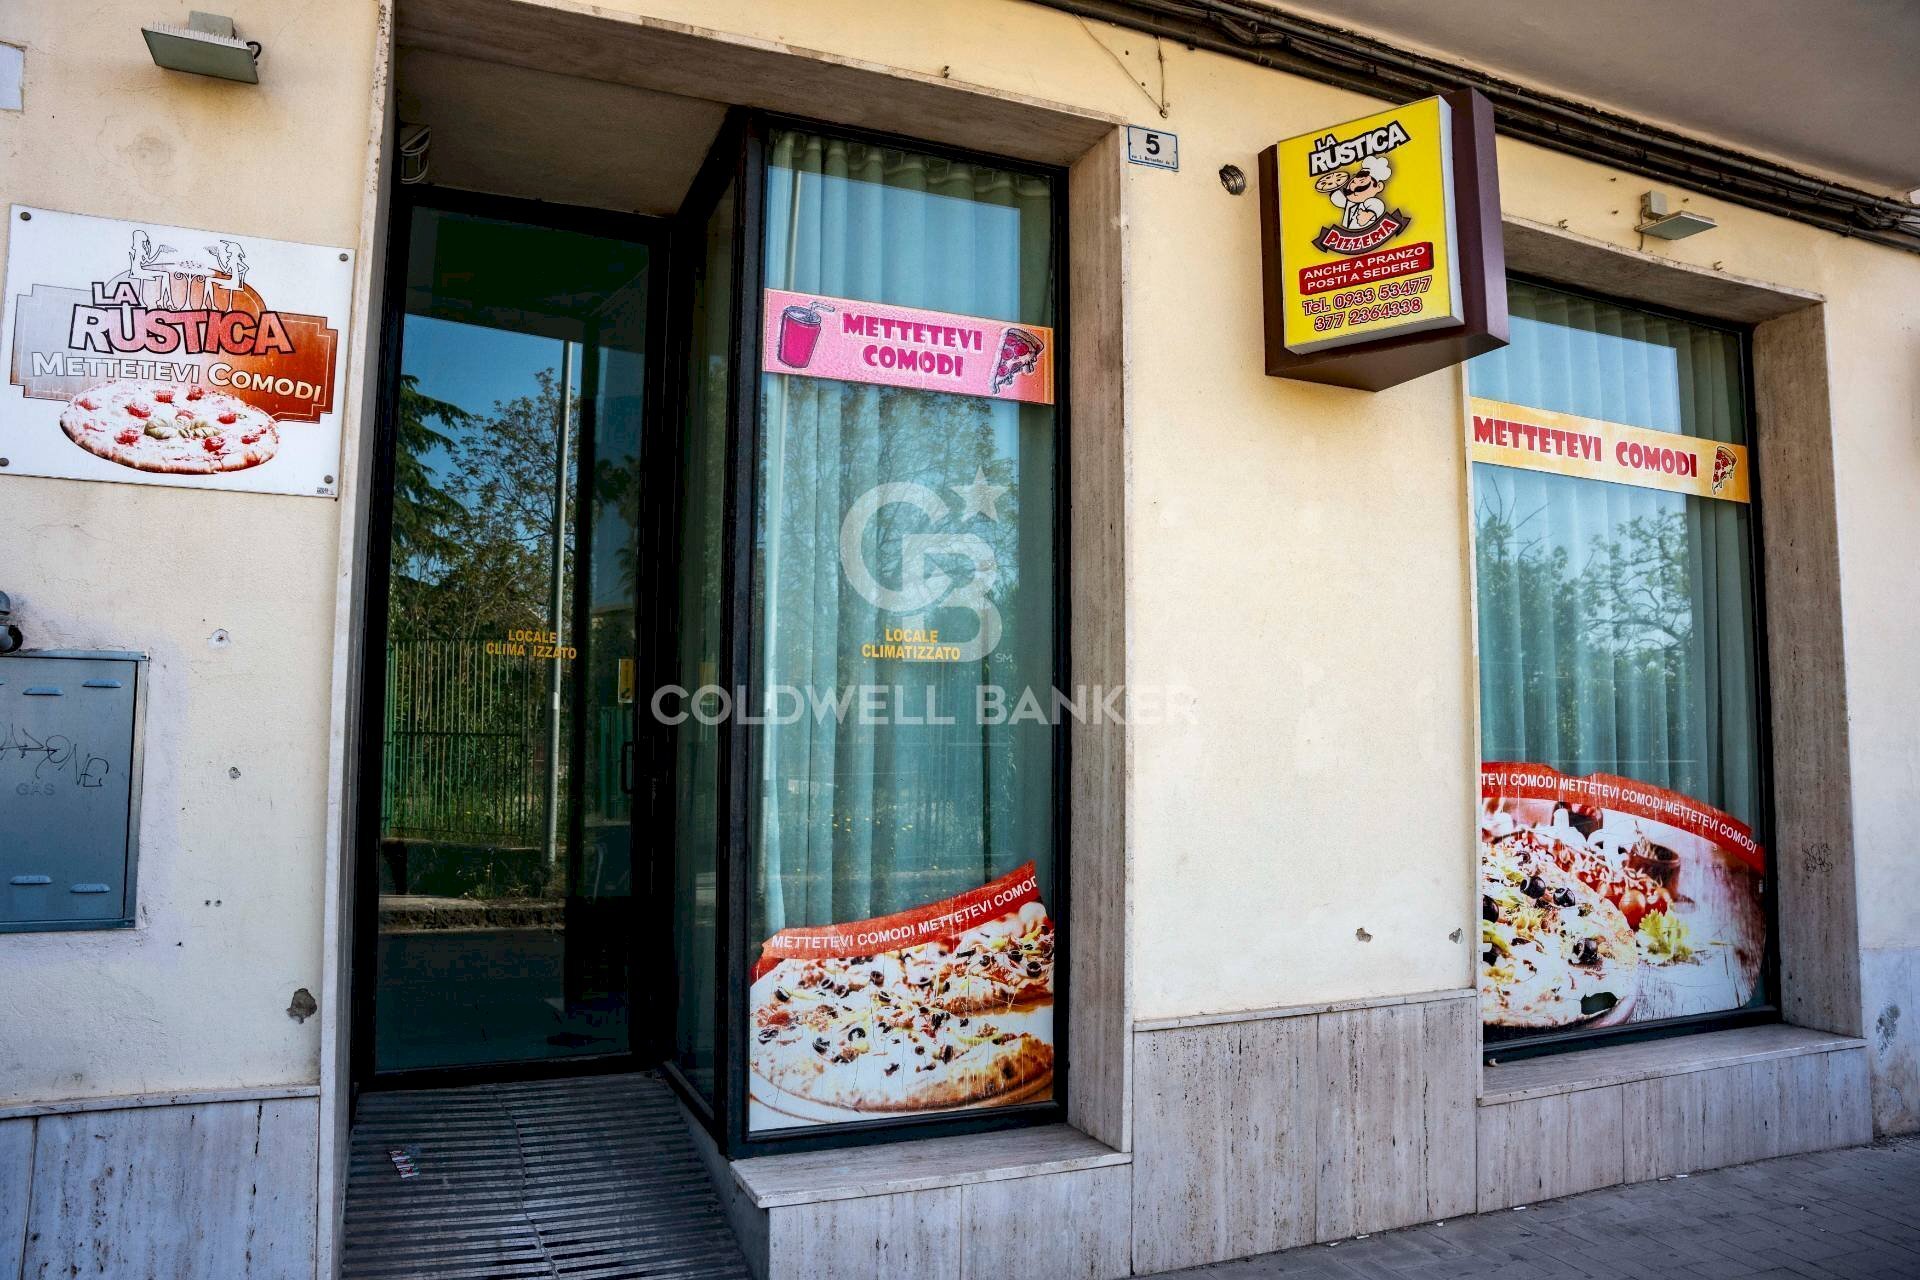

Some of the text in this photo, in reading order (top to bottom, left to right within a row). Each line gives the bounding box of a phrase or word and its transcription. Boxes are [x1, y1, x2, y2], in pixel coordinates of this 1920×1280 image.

[1146, 133, 1160, 155] 5
[1309, 121, 1410, 176] RUSTICA
[1315, 134, 1338, 151] LA
[1323, 218, 1400, 251] PIZZERIA
[1304, 246, 1425, 280] ANCHE A PRANZO
[1307, 260, 1419, 290] POSTI A SEDERE
[92, 282, 140, 306] LA
[1302, 275, 1432, 316] Tel. 0933 53477
[69, 303, 296, 355] RUSTICA
[1314, 297, 1422, 331] 377 2364338
[842, 312, 983, 351] METTETEVI
[32, 351, 321, 403] METTETEVI COMODI
[862, 344, 964, 377] COMODI
[1472, 415, 1698, 478] METTETEVI COMODI
[508, 629, 557, 643] LOCALE
[861, 644, 961, 661] CLIMATIZZATO
[885, 628, 938, 643] LOCALE
[1510, 773, 1557, 790] COMODI
[1559, 778, 1620, 799] METTETEVI
[1621, 788, 1663, 809] COMODI
[1664, 800, 1719, 832] METTETEVI
[1719, 823, 1757, 854] COMODI
[771, 934, 853, 949] METTETEVI
[857, 924, 916, 946] COMODI
[918, 899, 993, 935] METTETEVI
